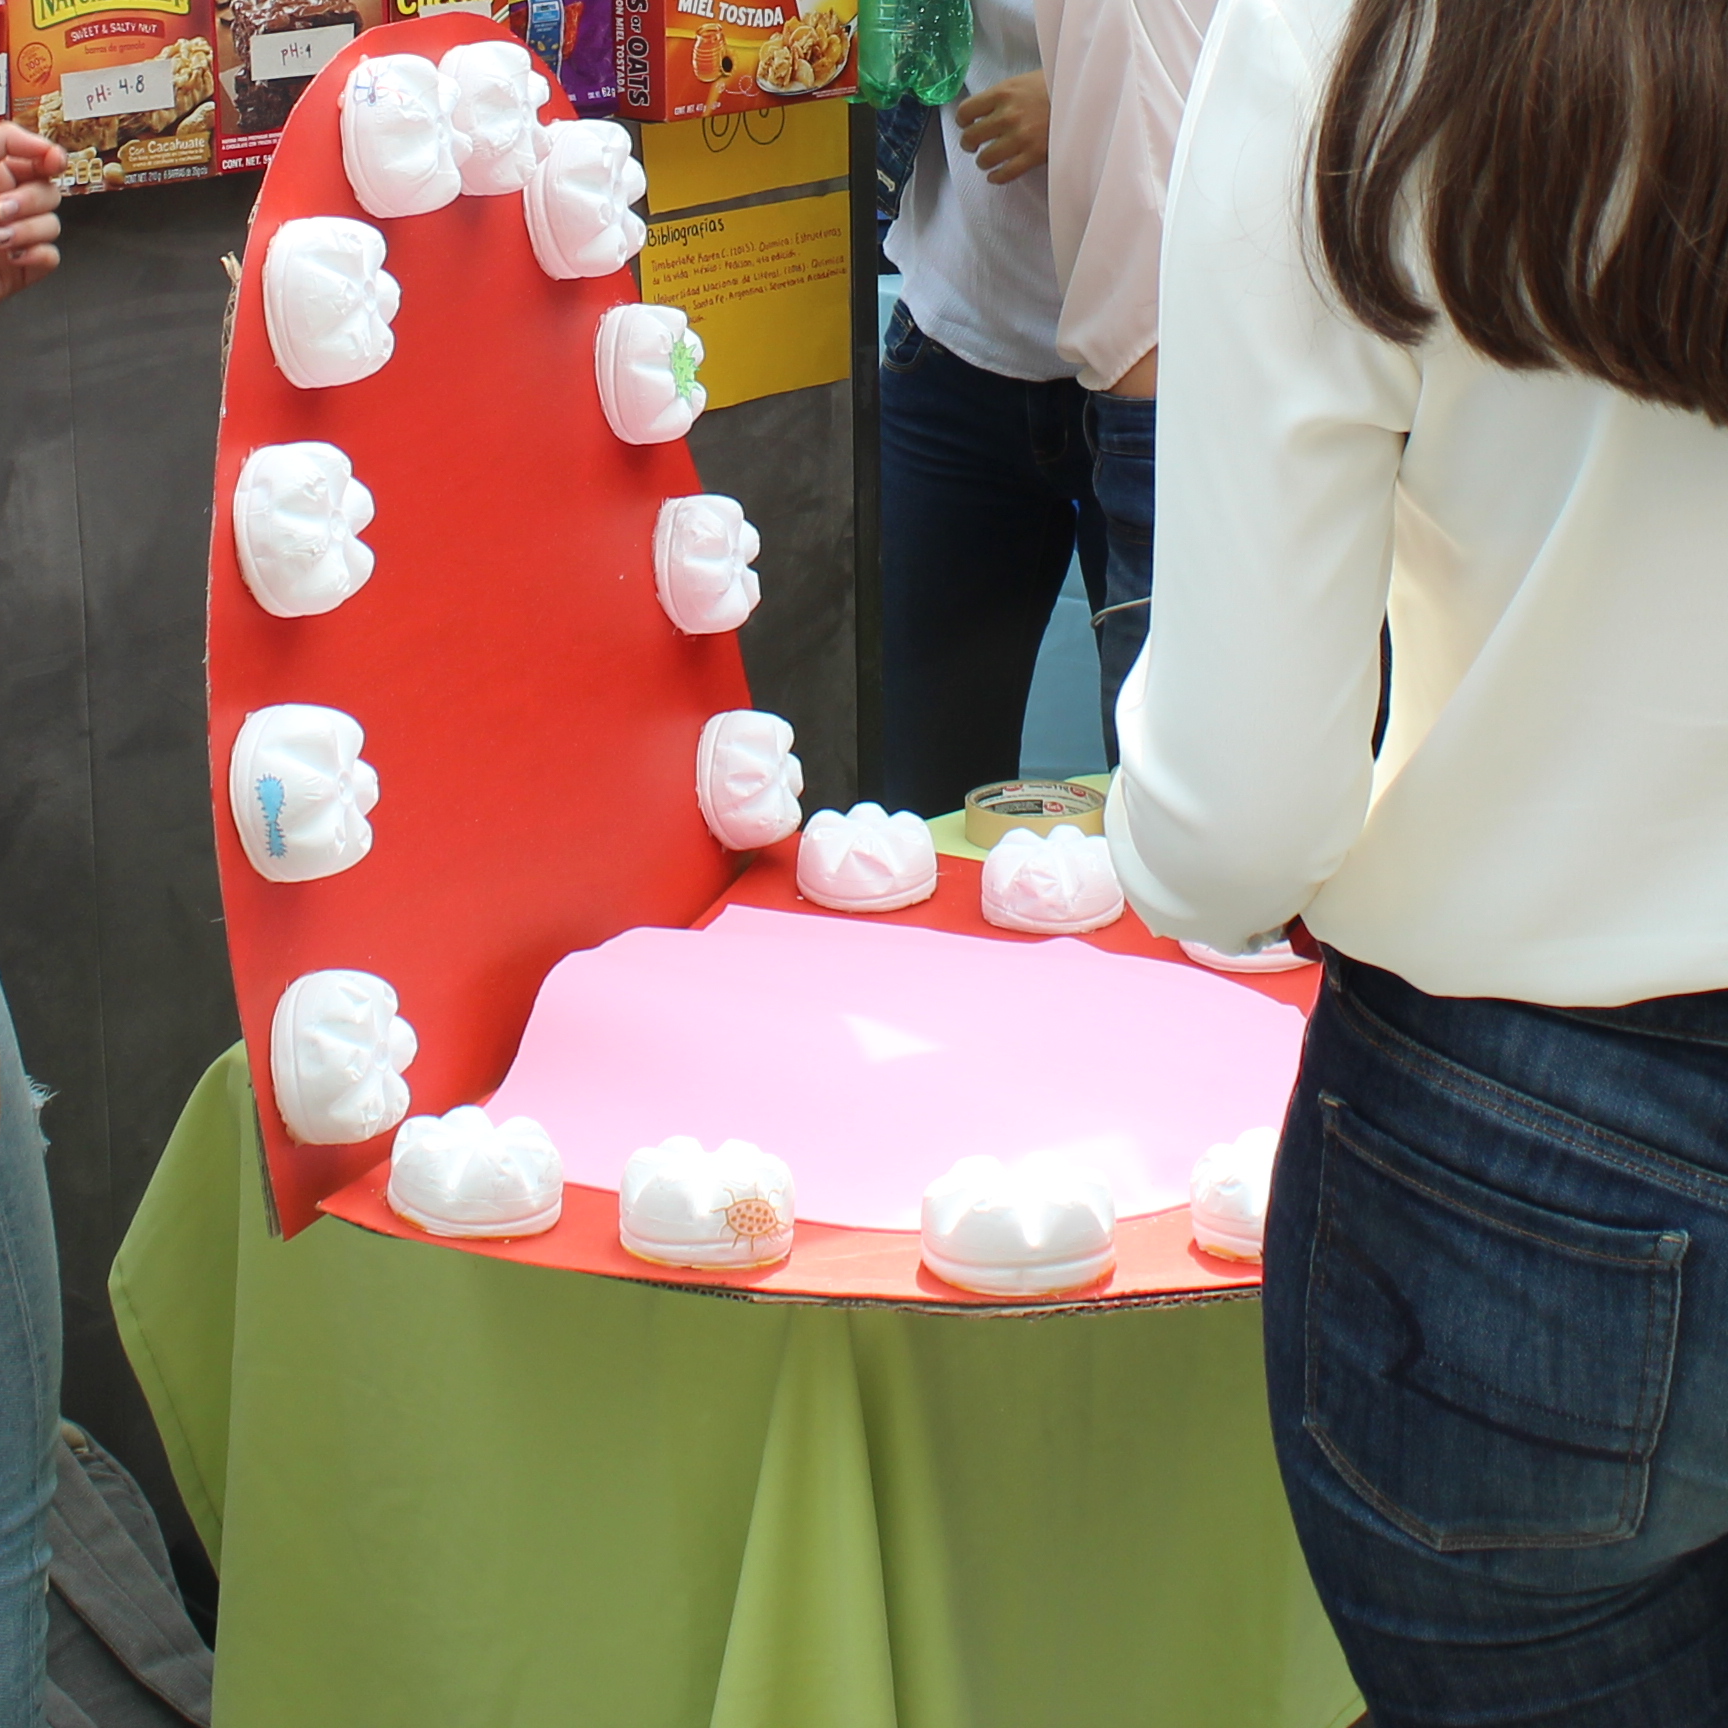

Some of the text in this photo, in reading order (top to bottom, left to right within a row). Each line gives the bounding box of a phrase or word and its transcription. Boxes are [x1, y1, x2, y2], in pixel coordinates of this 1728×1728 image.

[631, 16, 641, 33] OF
[718, 2, 784, 28] TOSTADA
[71, 21, 157, 42] SWEET & SALTY NUT
[615, 17, 625, 41] MIEL
[616, 44, 625, 94] TOSTADA
[627, 36, 649, 107] OATS
[86, 84, 112, 111] pH:
[148, 138, 205, 153] Cacahuate
[647, 218, 725, 248] Bibliografías
